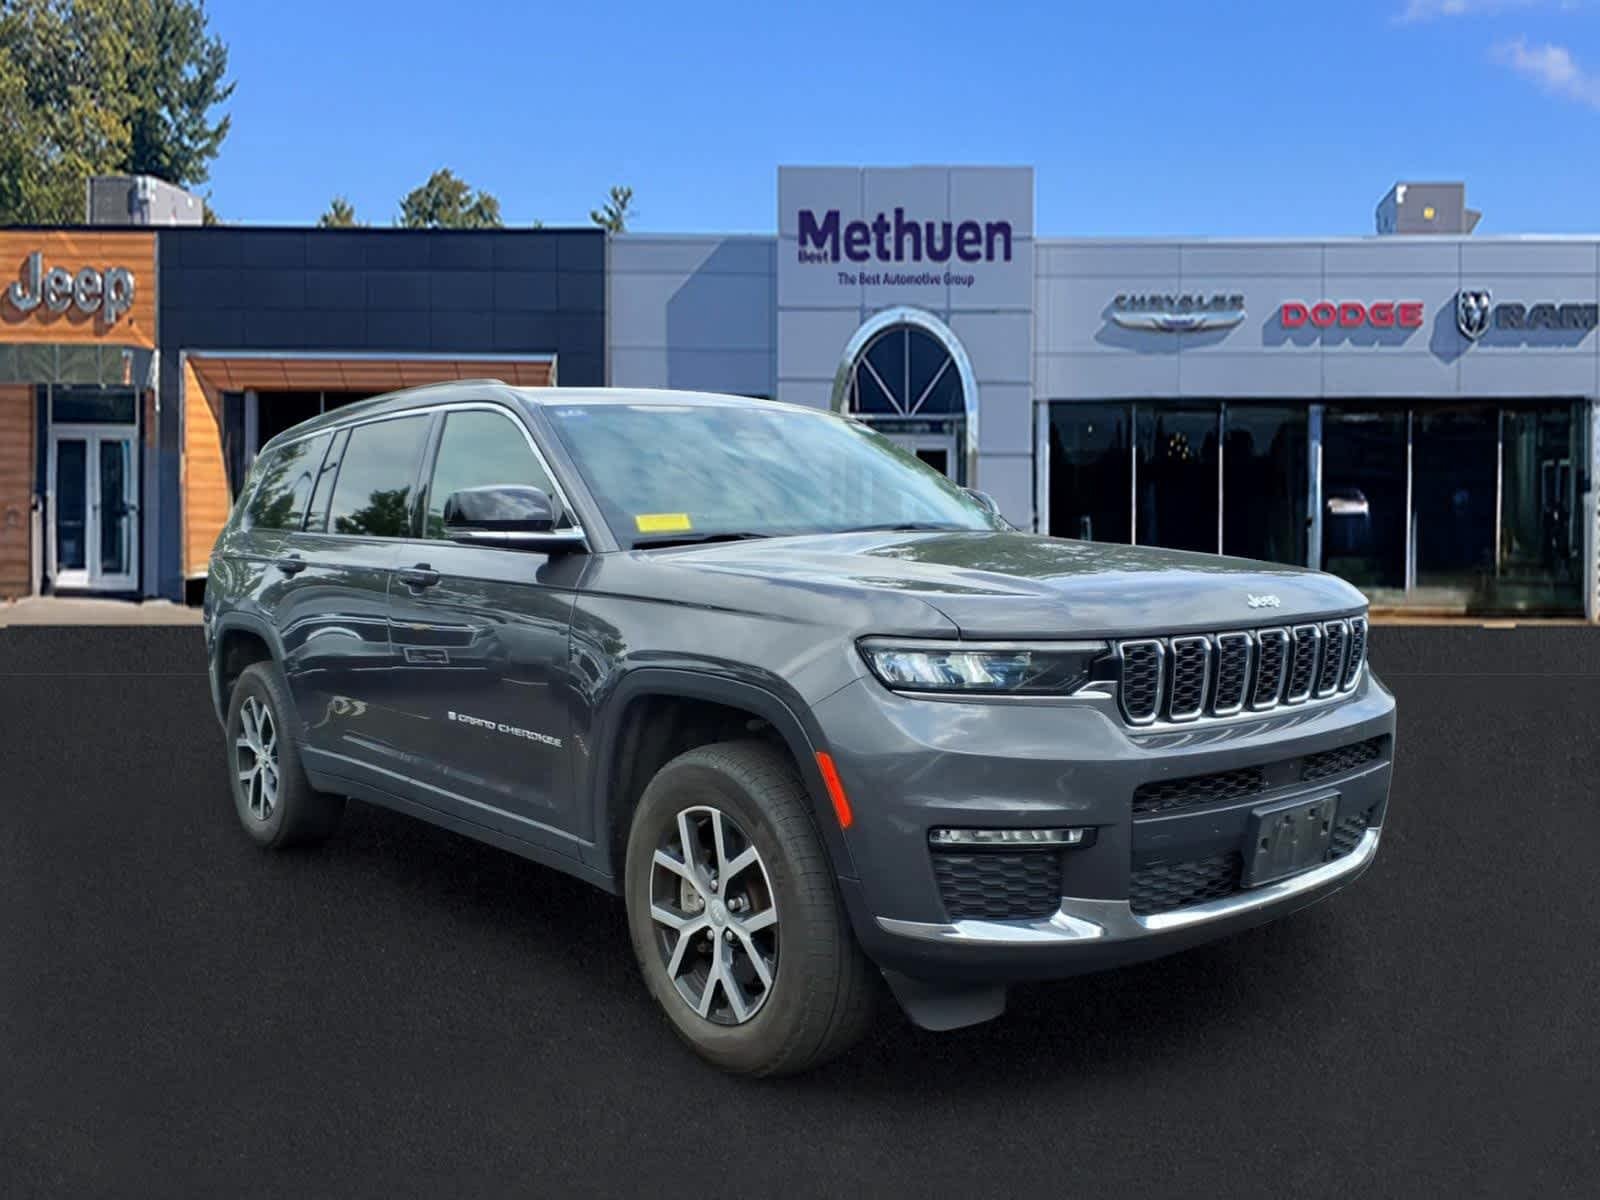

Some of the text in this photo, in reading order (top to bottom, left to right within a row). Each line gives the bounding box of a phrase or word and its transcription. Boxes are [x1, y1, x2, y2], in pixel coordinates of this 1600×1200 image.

[798, 207, 1012, 262] Methuen
[8, 252, 135, 324] Jeep
[837, 272, 975, 287] The Best Automotive Group
[1282, 302, 1424, 327] DODGE
[1494, 303, 1598, 329] RAM
[1247, 593, 1281, 608] Jeep
